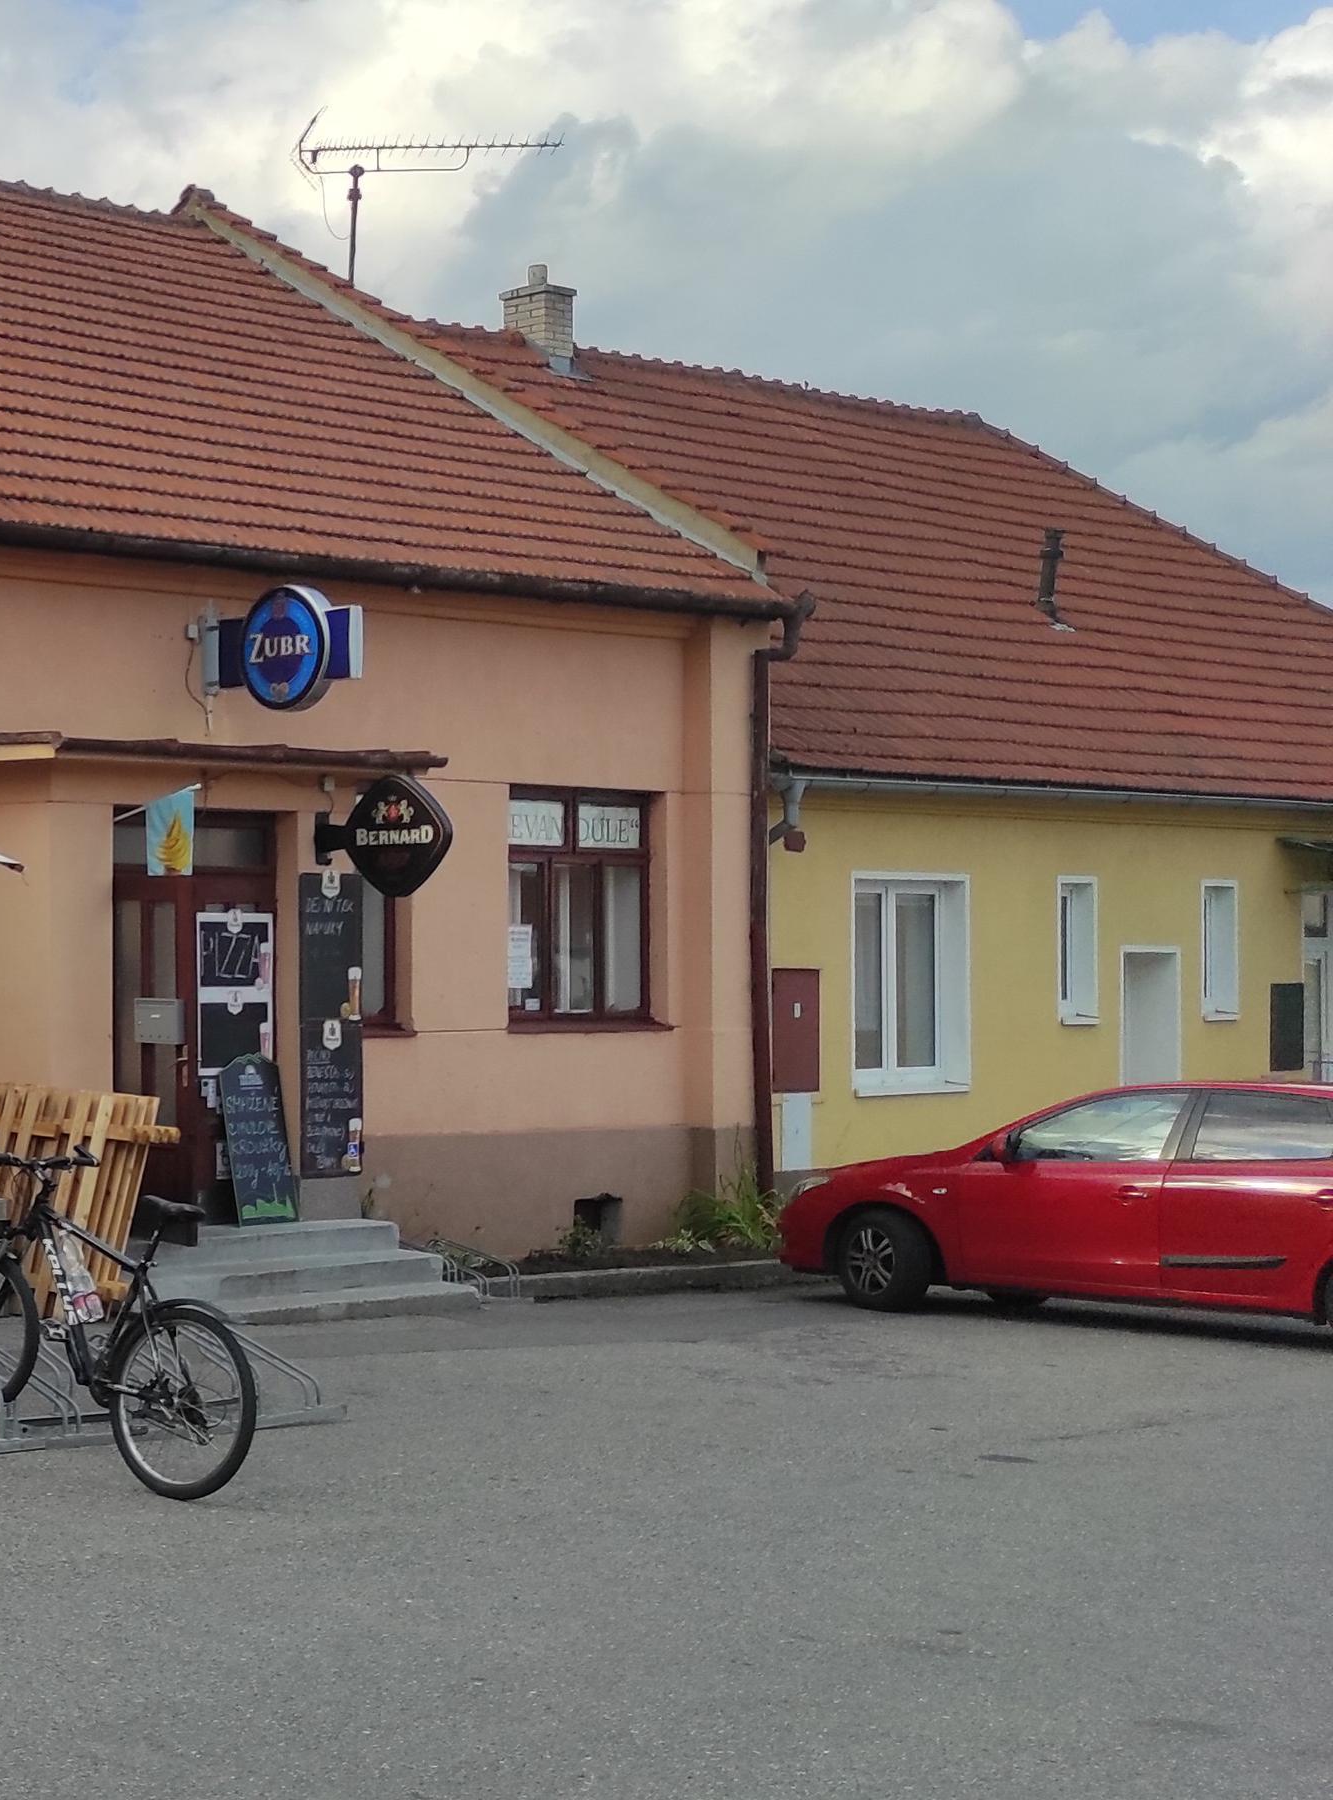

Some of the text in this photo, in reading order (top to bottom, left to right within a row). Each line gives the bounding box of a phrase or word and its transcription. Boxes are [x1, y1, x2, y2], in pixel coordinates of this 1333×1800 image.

[249, 633, 311, 663] ZUBR
[355, 825, 434, 846] BERNARD
[201, 930, 261, 978] PIZZA
